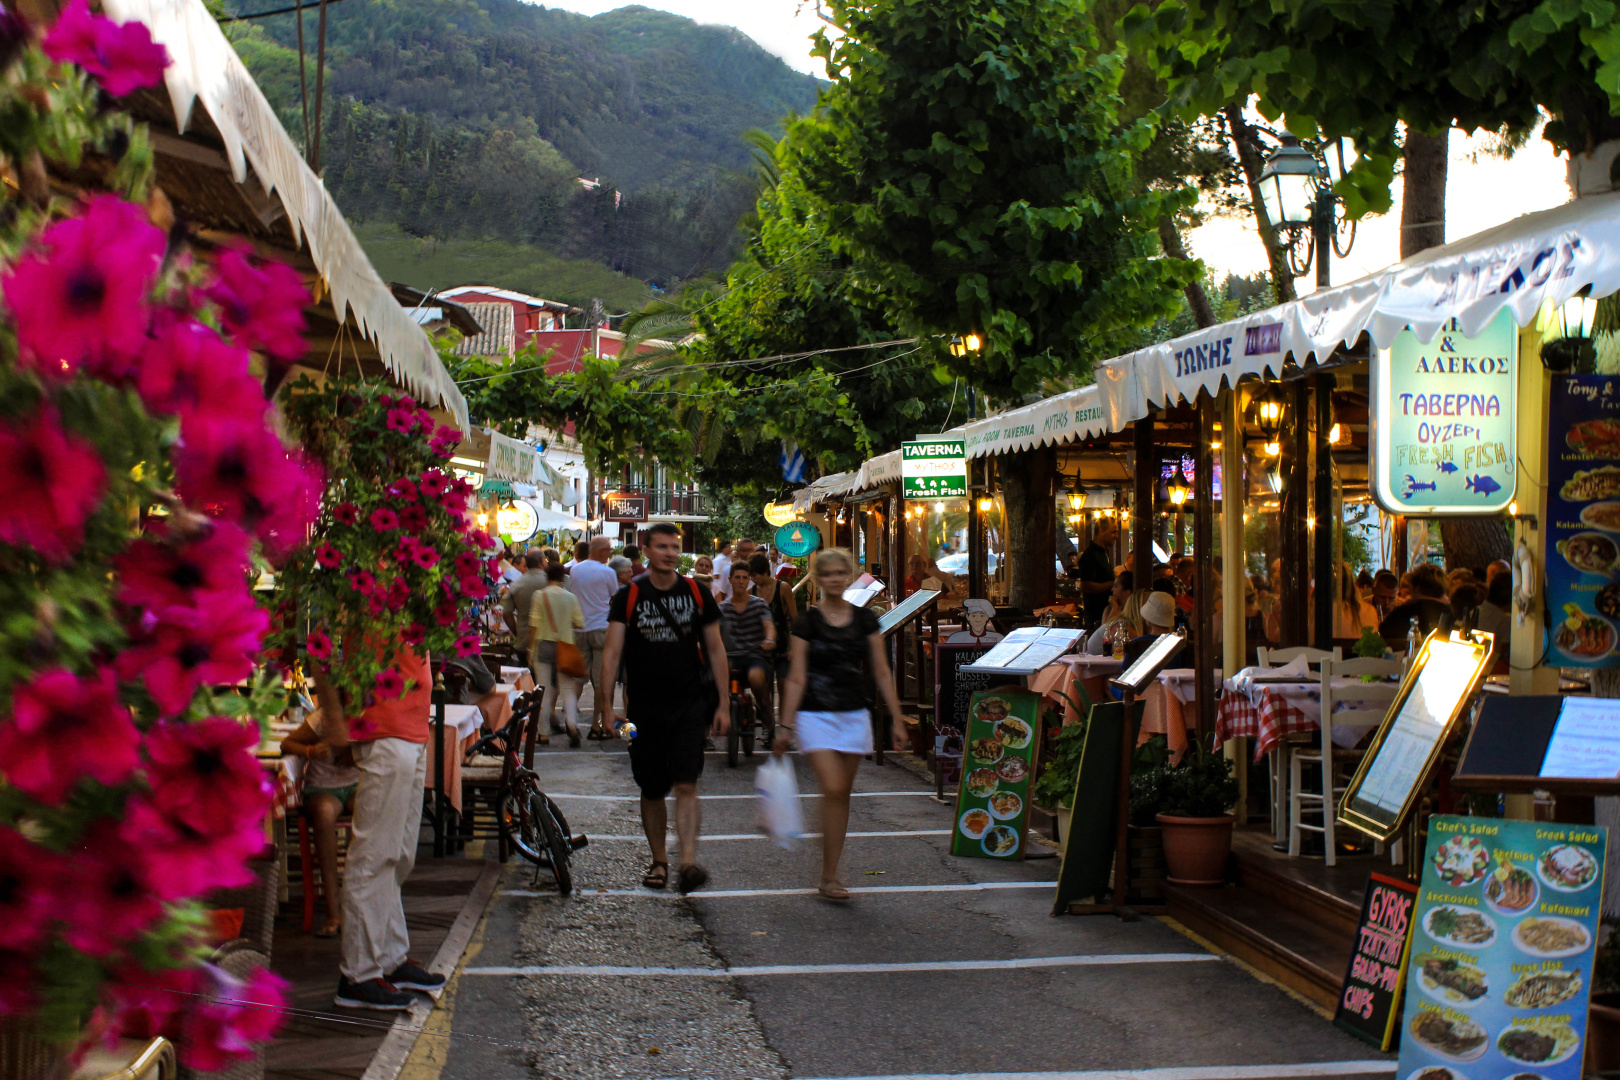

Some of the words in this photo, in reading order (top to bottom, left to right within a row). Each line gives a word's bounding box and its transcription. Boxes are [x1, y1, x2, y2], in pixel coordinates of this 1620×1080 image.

[1440, 335, 1456, 352] &
[1415, 356, 1509, 374] ΑΛΕΚΟΣ
[1566, 379, 1598, 401] Tony
[1602, 381, 1614, 395] &
[1399, 393, 1500, 416] ΤΑΒΕΡΝΑ
[1003, 424, 1035, 439] TAVERNA
[1043, 411, 1068, 432] MYTHOS
[903, 444, 963, 456] TAVERNA
[1396, 444, 1453, 466] FRESH
[1464, 442, 1506, 469] FISH
[913, 462, 955, 473] MYTHOS
[905, 488, 937, 496] Fresh
[782, 523, 812, 531] TAVERNA
[955, 672, 991, 681] MUSSELS
[955, 681, 988, 691] SHRIMPS
[1436, 821, 1467, 833] Chef's
[1469, 824, 1498, 835] Salad
[1536, 829, 1565, 840] Greek
[1569, 830, 1599, 843] Salad
[1493, 848, 1534, 862] Shrimps
[1426, 892, 1479, 906] Anchovies
[1369, 886, 1411, 936] GYROS
[1539, 902, 1590, 916] Kalamari
[1358, 926, 1402, 965] TZATZIKI
[1343, 985, 1375, 1019] CHIPS
[1418, 1000, 1442, 1014] Pork
